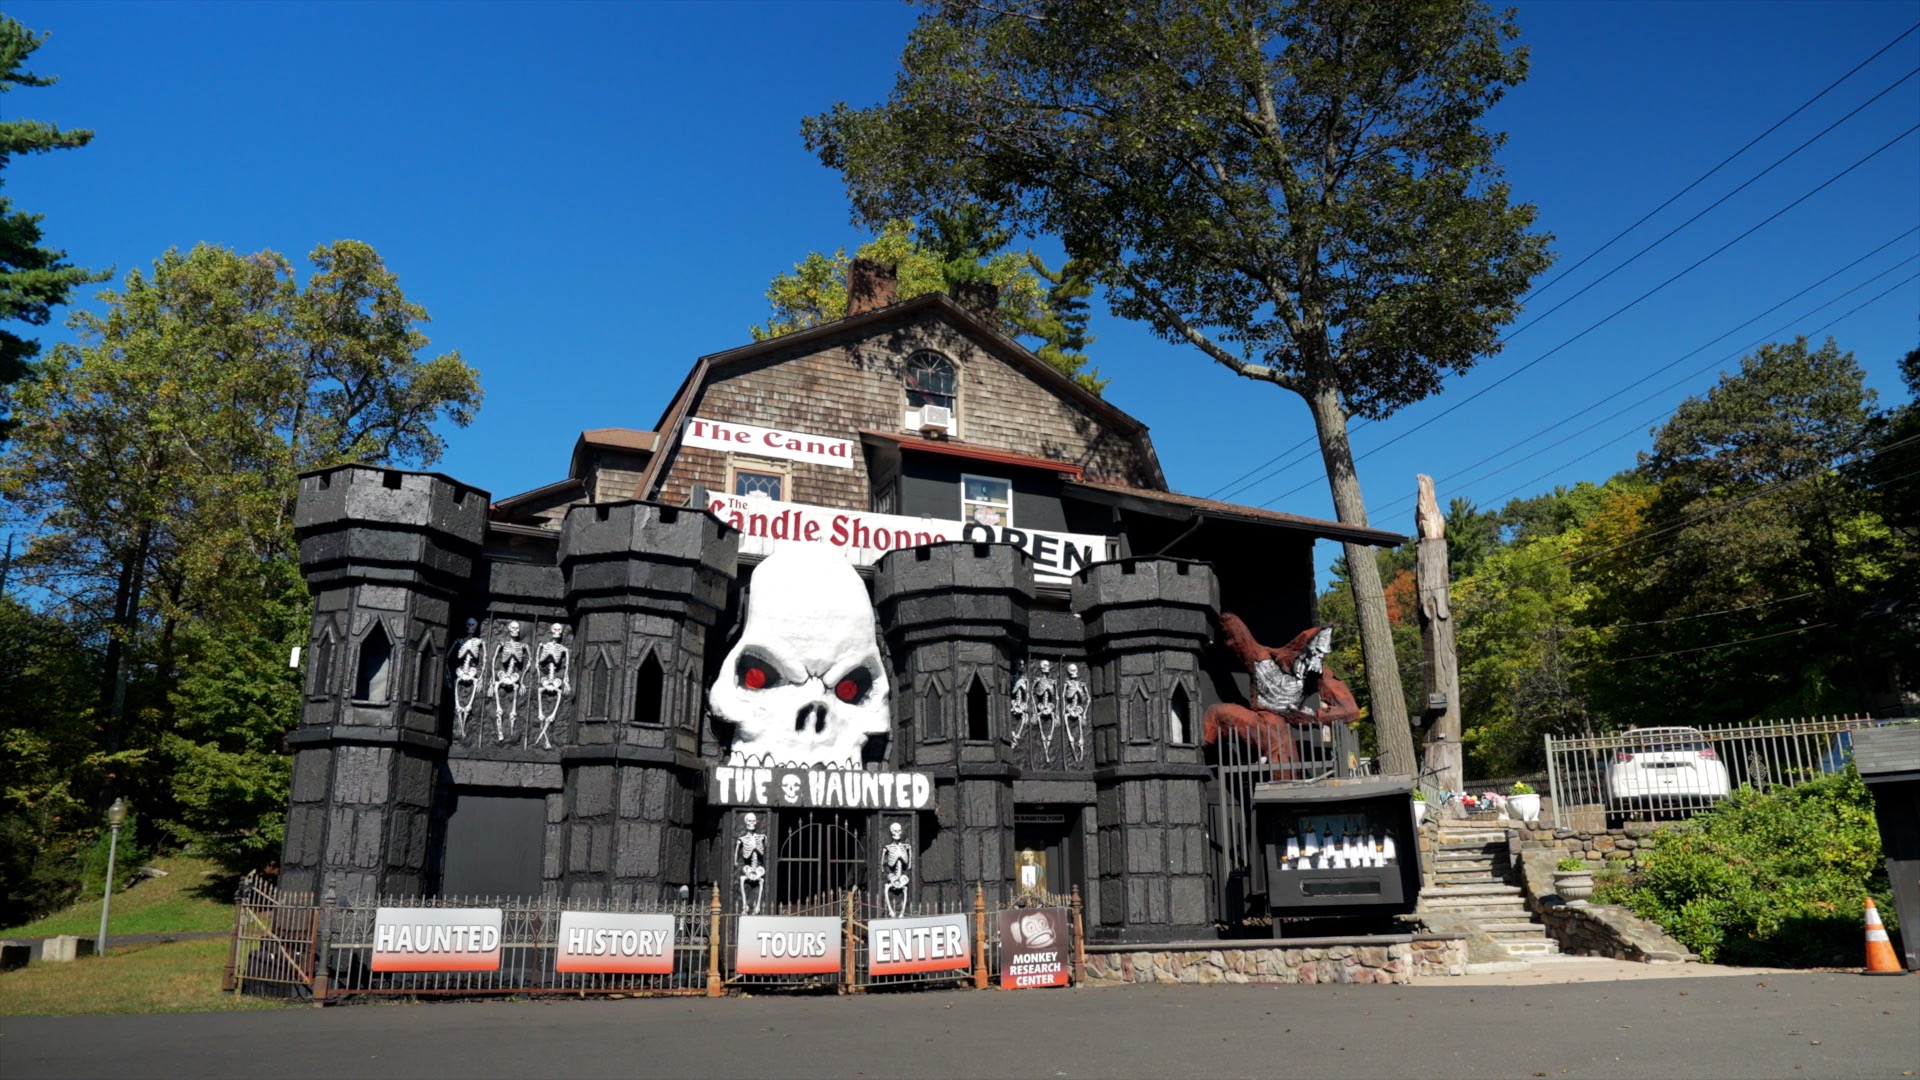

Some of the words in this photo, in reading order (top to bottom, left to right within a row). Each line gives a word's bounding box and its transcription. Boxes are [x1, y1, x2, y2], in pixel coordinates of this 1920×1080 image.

[690, 419, 751, 443] The
[728, 497, 748, 510] The
[963, 523, 1092, 571] OPEN
[716, 767, 772, 804] THE
[808, 770, 930, 808] HAUNTED
[376, 924, 499, 953] HAUNTED
[567, 927, 668, 956] HISTORY
[757, 931, 826, 958] TOURS
[875, 923, 964, 963] ENTER
[1009, 962, 1061, 976] RESEARCH
[1013, 951, 1058, 965] MONKEY
[1016, 974, 1055, 987] CENTER
